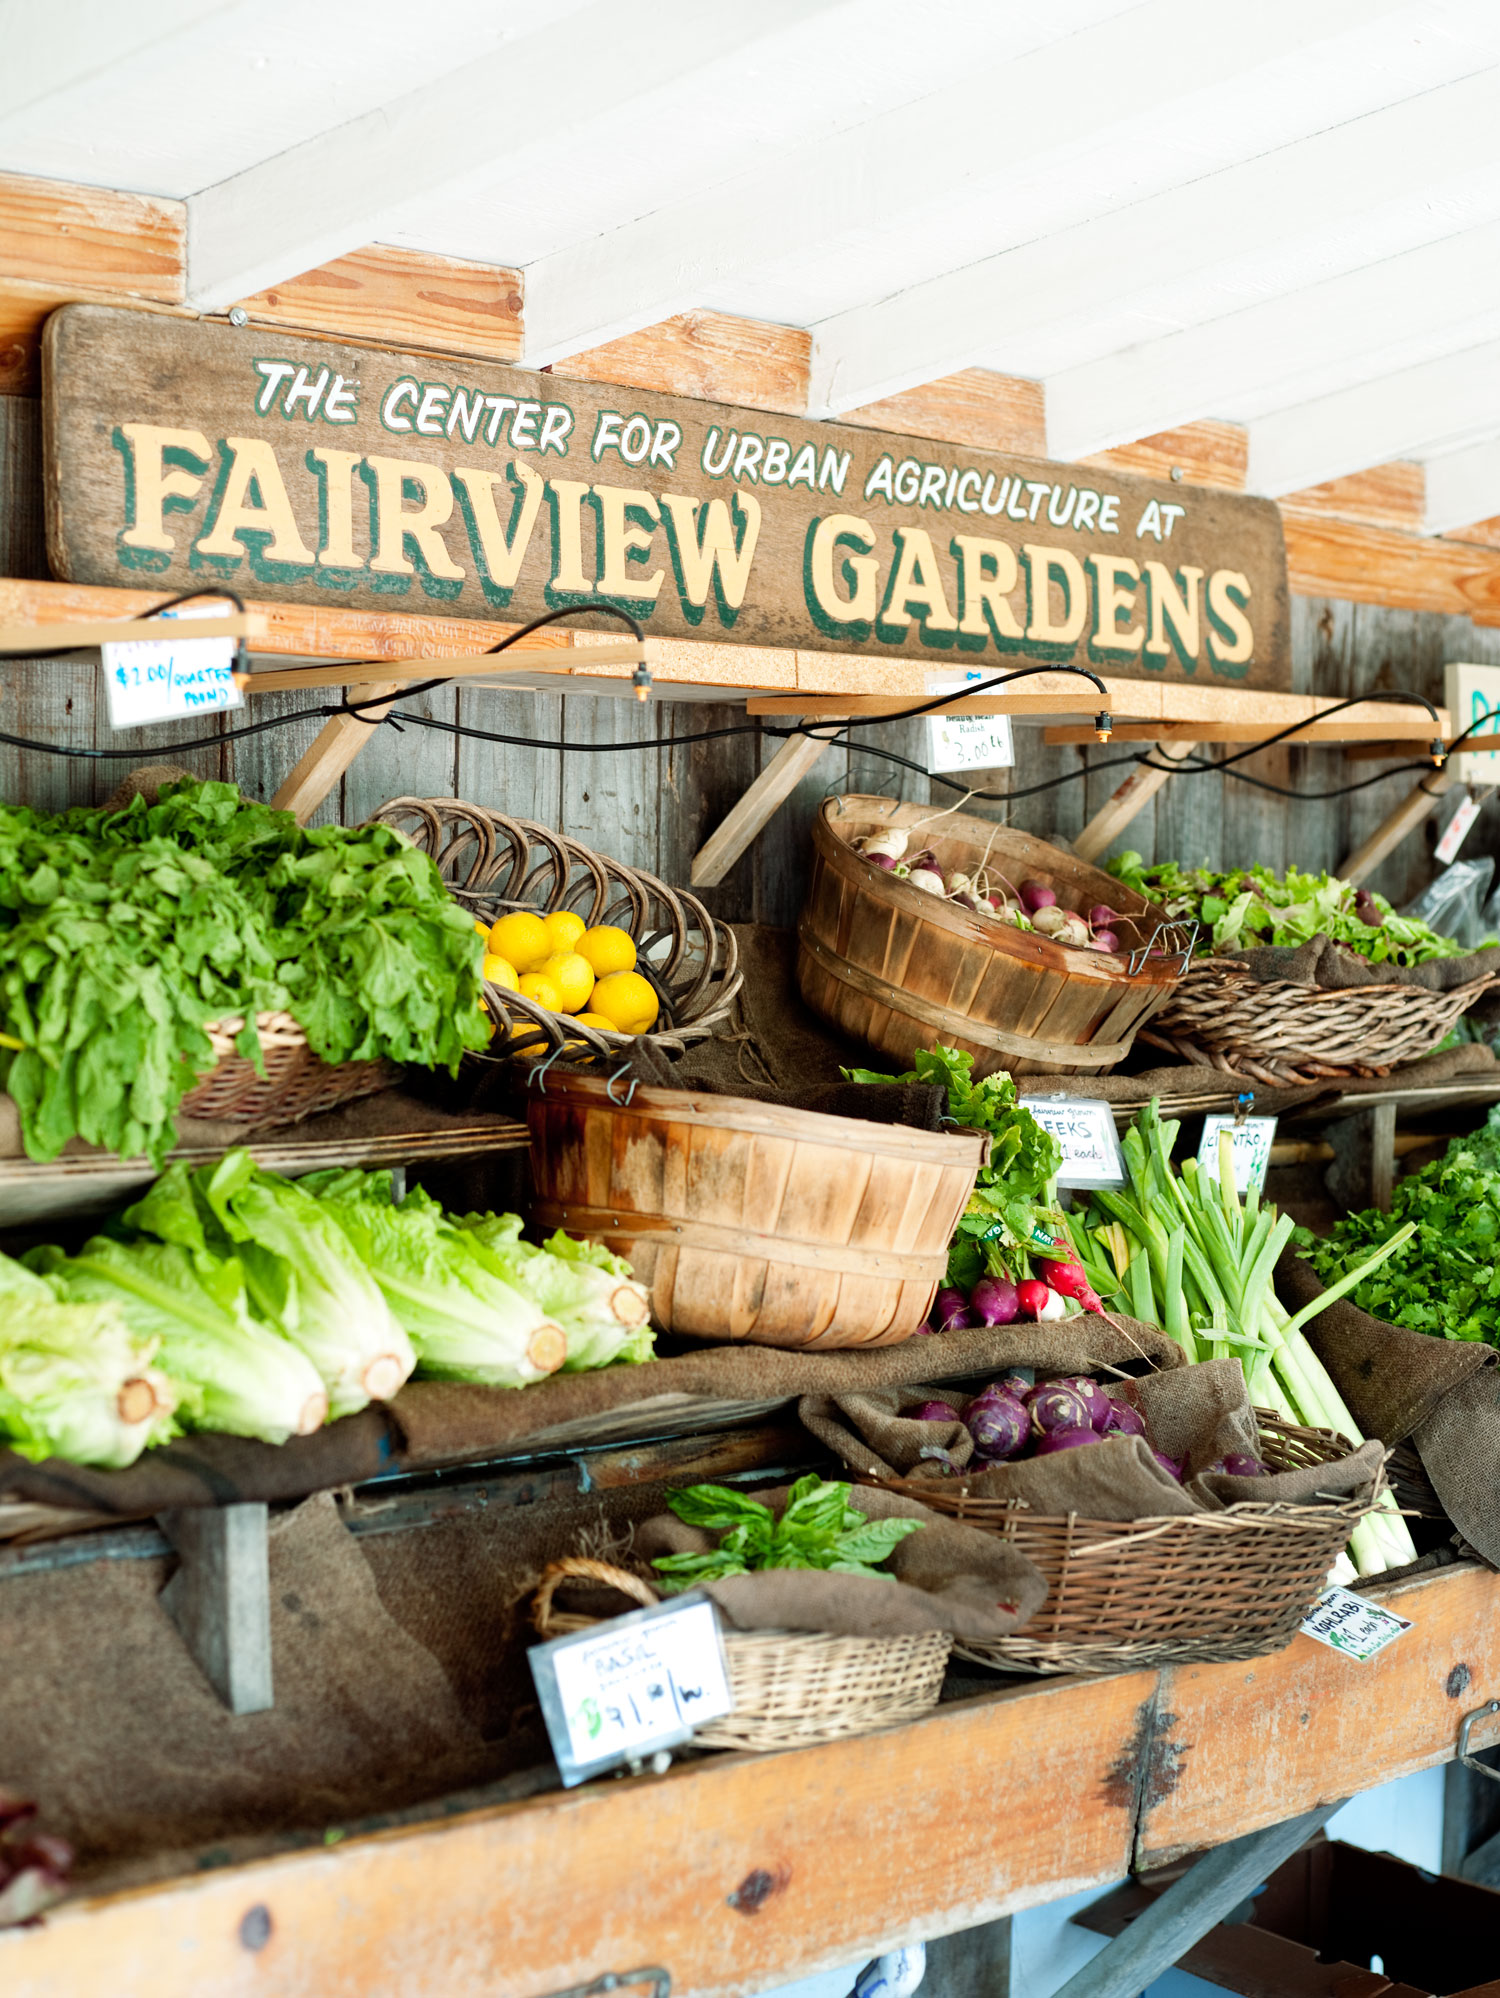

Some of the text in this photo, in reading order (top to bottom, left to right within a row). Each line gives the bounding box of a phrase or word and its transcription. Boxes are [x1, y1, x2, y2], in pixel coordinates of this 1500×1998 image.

[254, 359, 1186, 542] THE CENTER FOR URBAN AGRICULTURE AT
[114, 422, 1254, 674] FAIRVIEW GARDENS
[1043, 1120, 1092, 1139] EEKS
[1207, 1133, 1261, 1149] CINTRO
[1311, 1600, 1364, 1635] KOHLRABI
